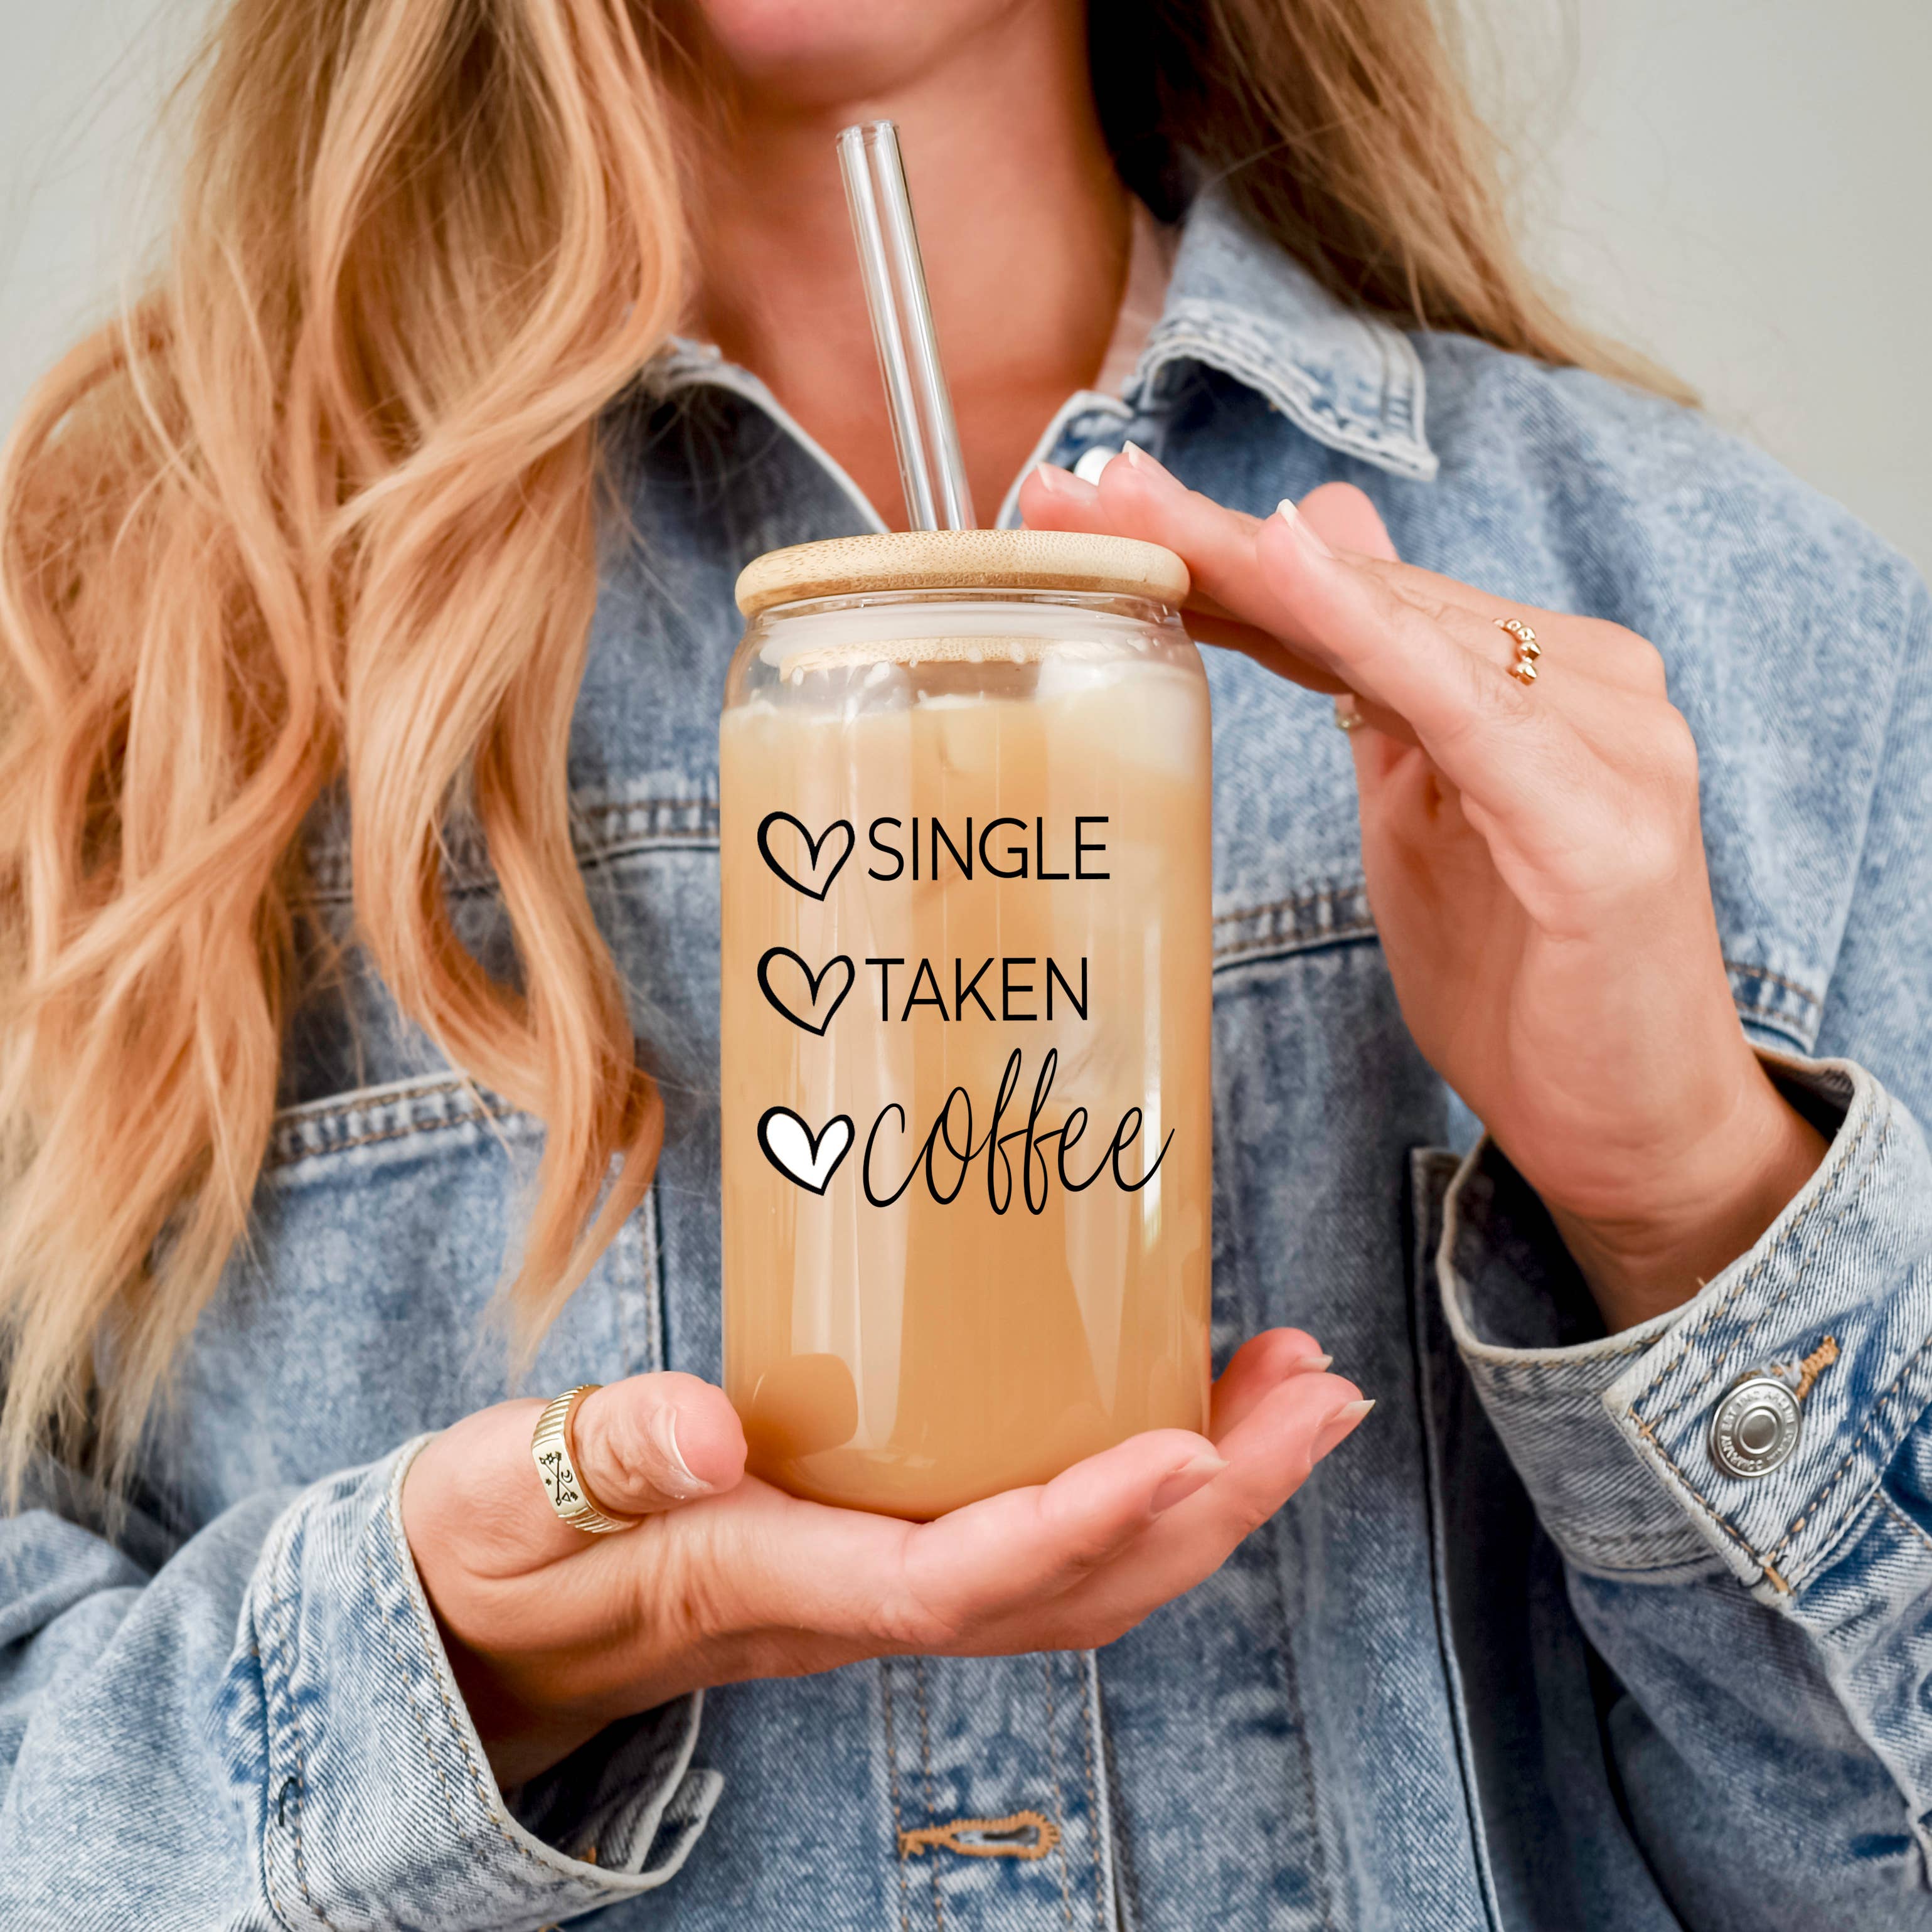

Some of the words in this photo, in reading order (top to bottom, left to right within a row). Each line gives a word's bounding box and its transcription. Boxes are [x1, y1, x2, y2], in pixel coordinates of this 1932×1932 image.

[868, 816, 1110, 881] SINGLE
[865, 957, 1088, 1022] TAKEN
[863, 1047, 1175, 1215] coffee
